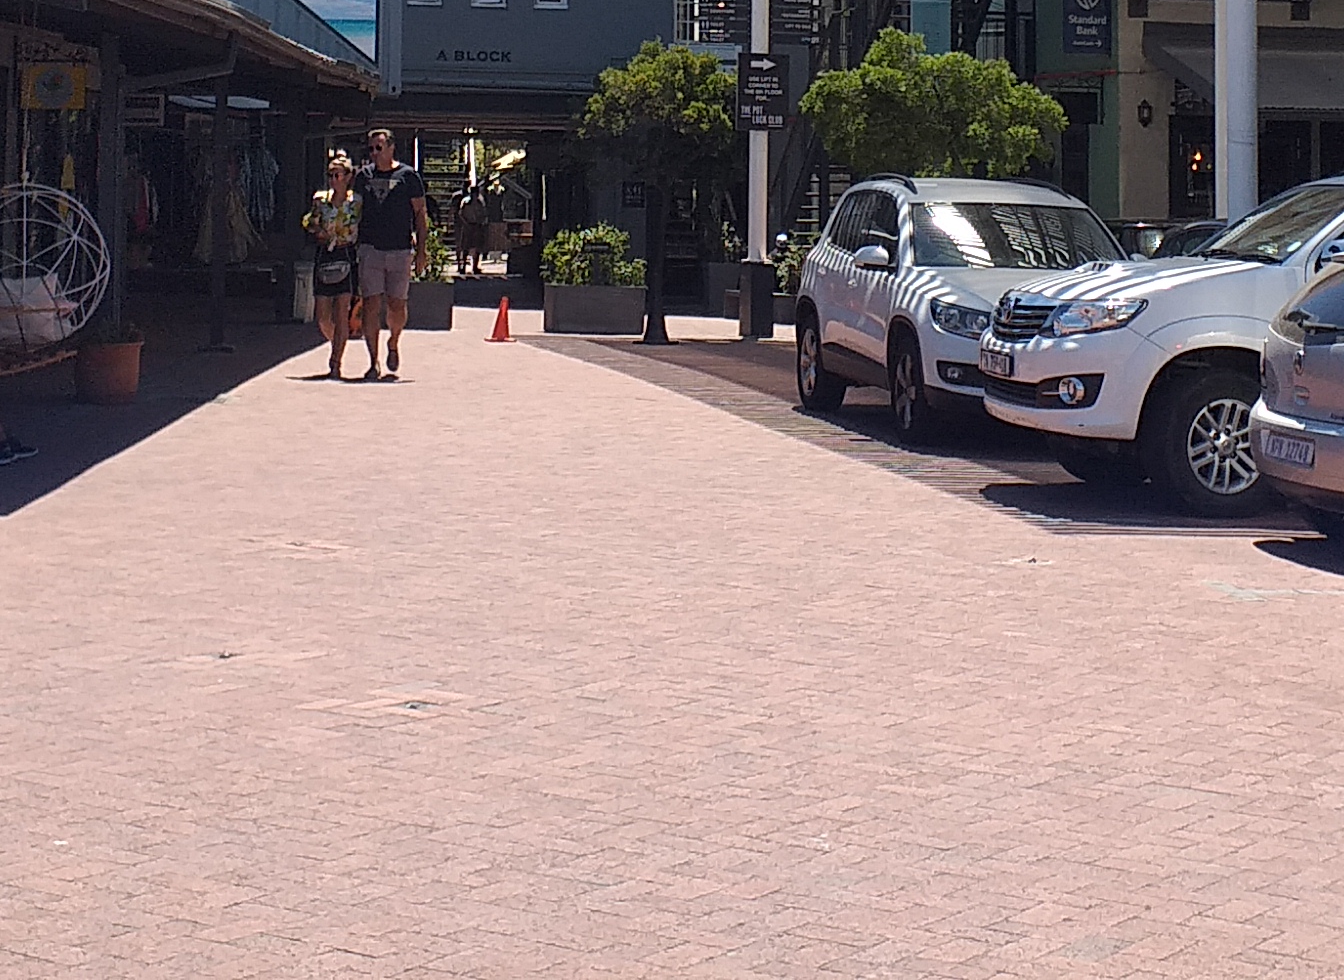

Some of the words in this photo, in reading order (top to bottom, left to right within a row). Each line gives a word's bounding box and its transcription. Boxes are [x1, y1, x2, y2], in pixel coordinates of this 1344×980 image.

[1068, 14, 1107, 25] Standard
[1076, 26, 1098, 35] Bank
[436, 50, 447, 61] A
[454, 50, 512, 63] BLOCK
[741, 105, 751, 114] THE
[752, 105, 763, 115] POT
[752, 115, 767, 124] LUCK
[768, 115, 783, 124] CLUB
